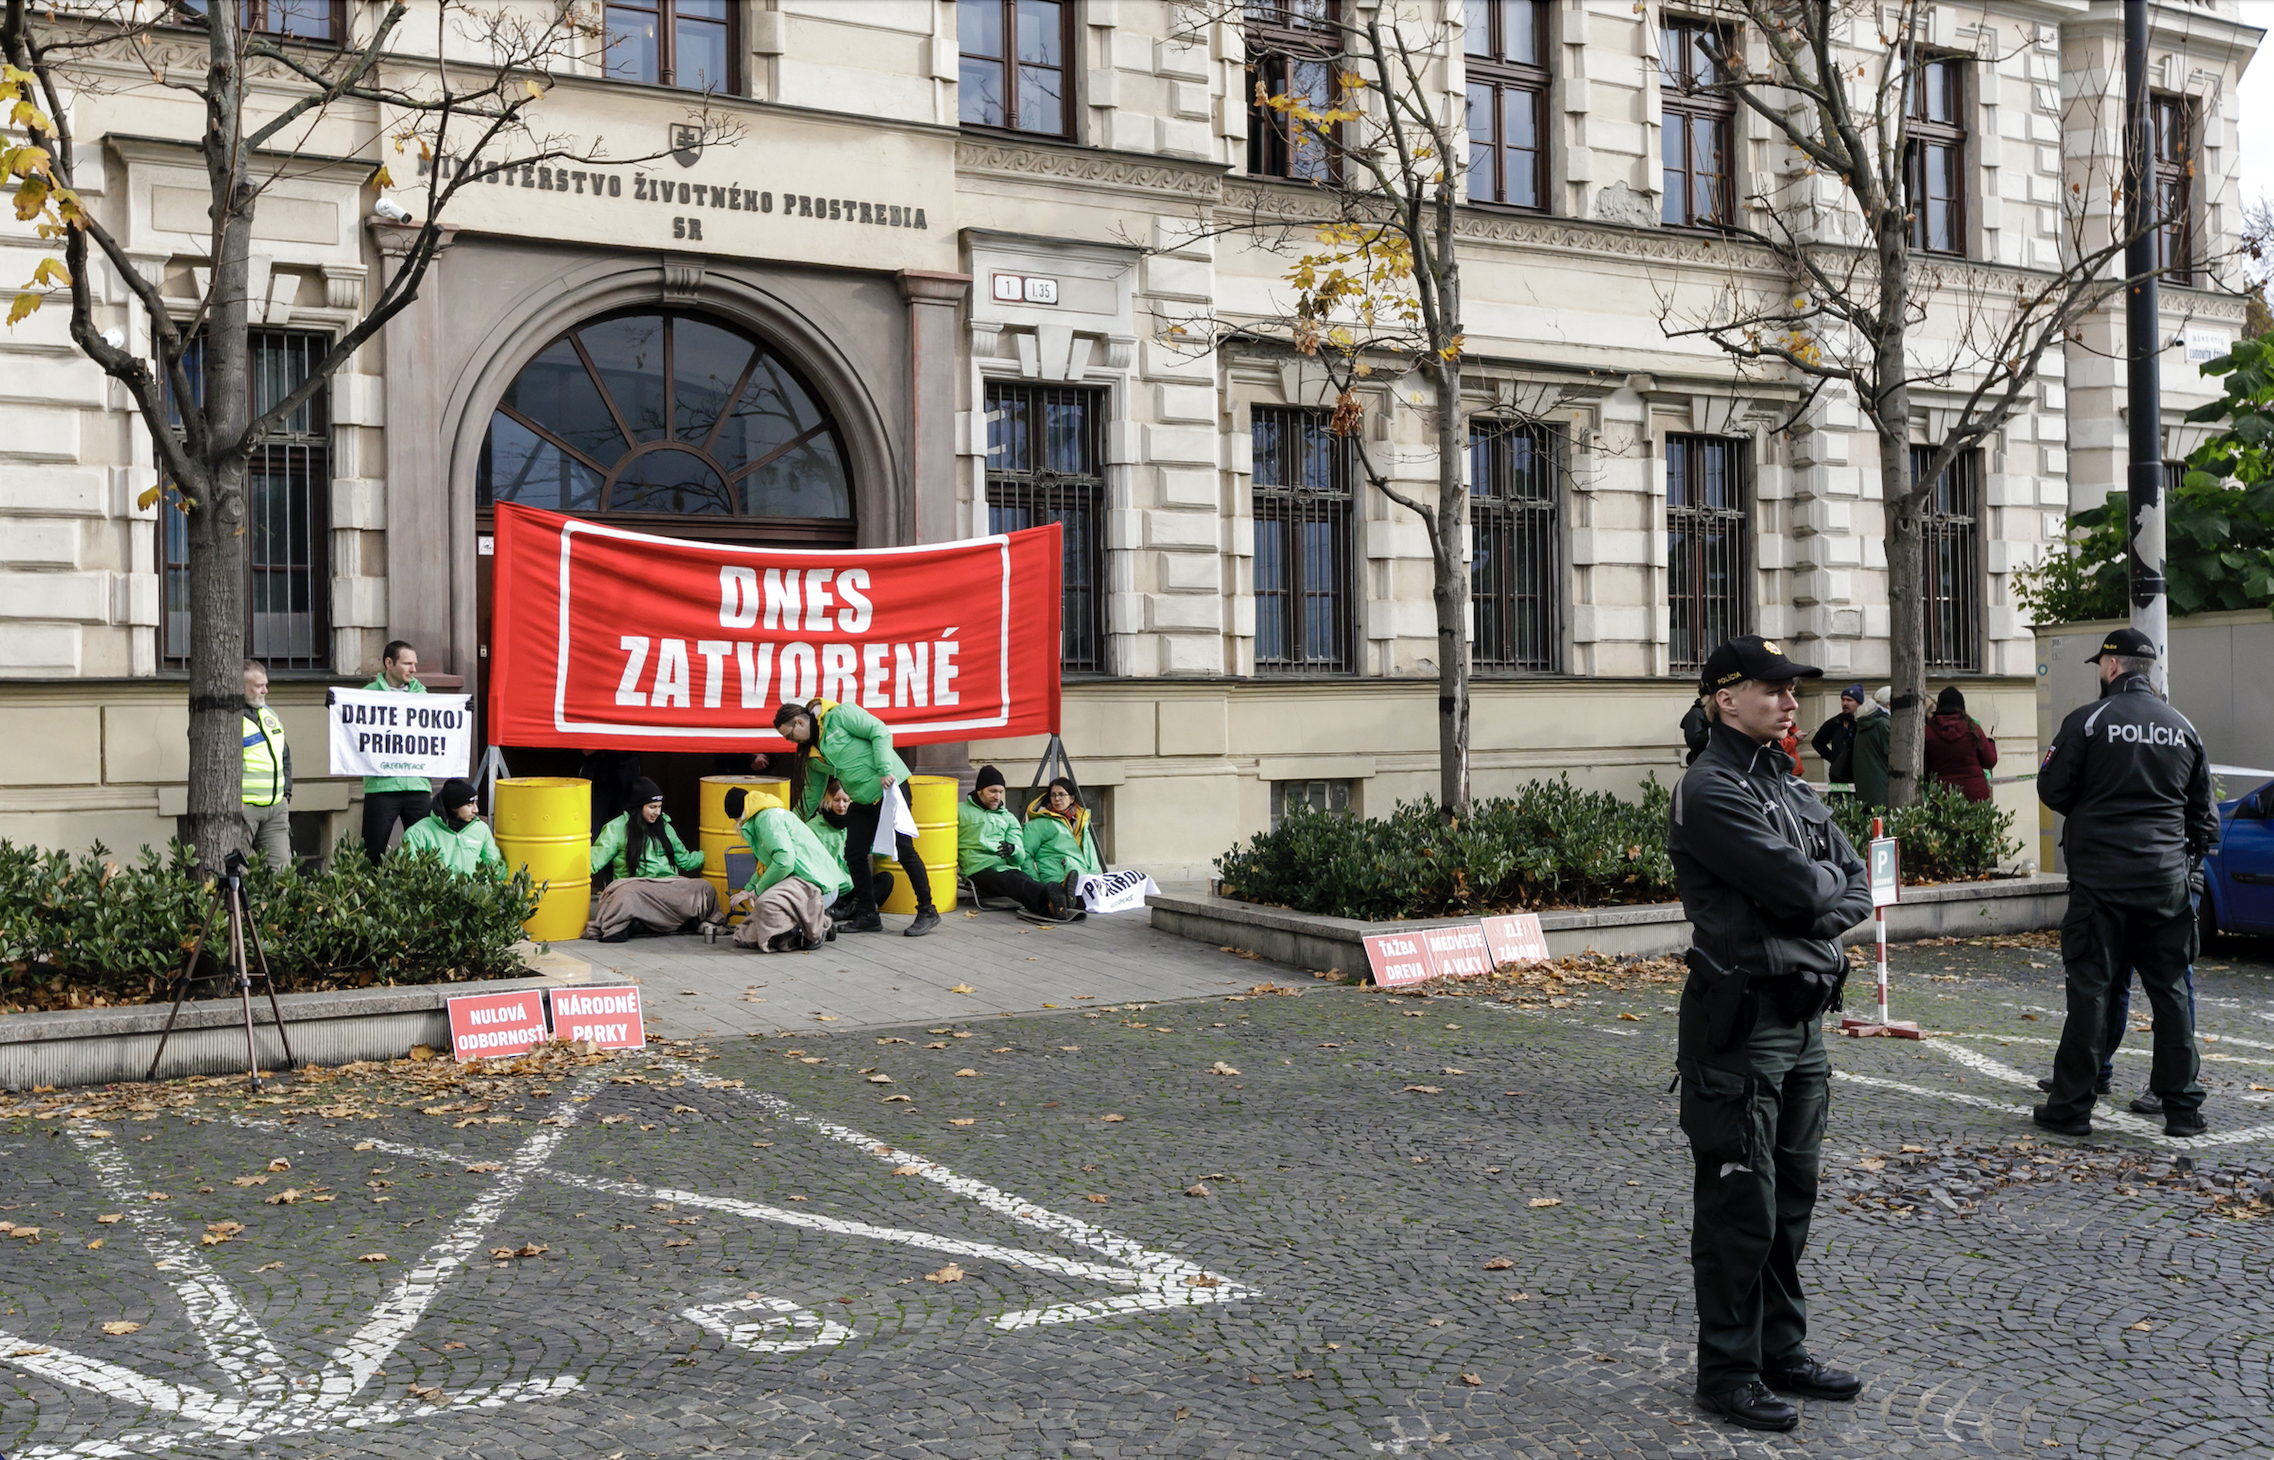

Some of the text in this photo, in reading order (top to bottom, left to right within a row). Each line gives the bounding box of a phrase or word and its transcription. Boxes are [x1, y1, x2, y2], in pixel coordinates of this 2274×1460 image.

[634, 171, 773, 214] ŽIVOTNÉHO
[783, 193, 928, 230] PROSTREDIA
[673, 216, 703, 241] SR
[1005, 280, 1011, 295] 1
[719, 565, 873, 633] DNES
[615, 627, 960, 708] ZATVORENÉ
[342, 704, 463, 730] DAJTE POKOJ
[359, 730, 446, 756] PRÍRODE!
[2107, 722, 2187, 748] POLÍCIA
[1877, 850, 1888, 874] P
[1503, 919, 1524, 938] ZLÉ
[1378, 939, 1418, 958] ŤAŽBA
[1429, 932, 1484, 952] MEDVEDE
[1385, 962, 1426, 980] DREVA
[1443, 956, 1482, 976] A VLKY
[469, 1003, 527, 1025] NULOVÁ
[557, 992, 637, 1016] NÁRODNÉ
[458, 1024, 545, 1050] ODBORNOSŤ
[572, 1023, 628, 1043] PARKY
